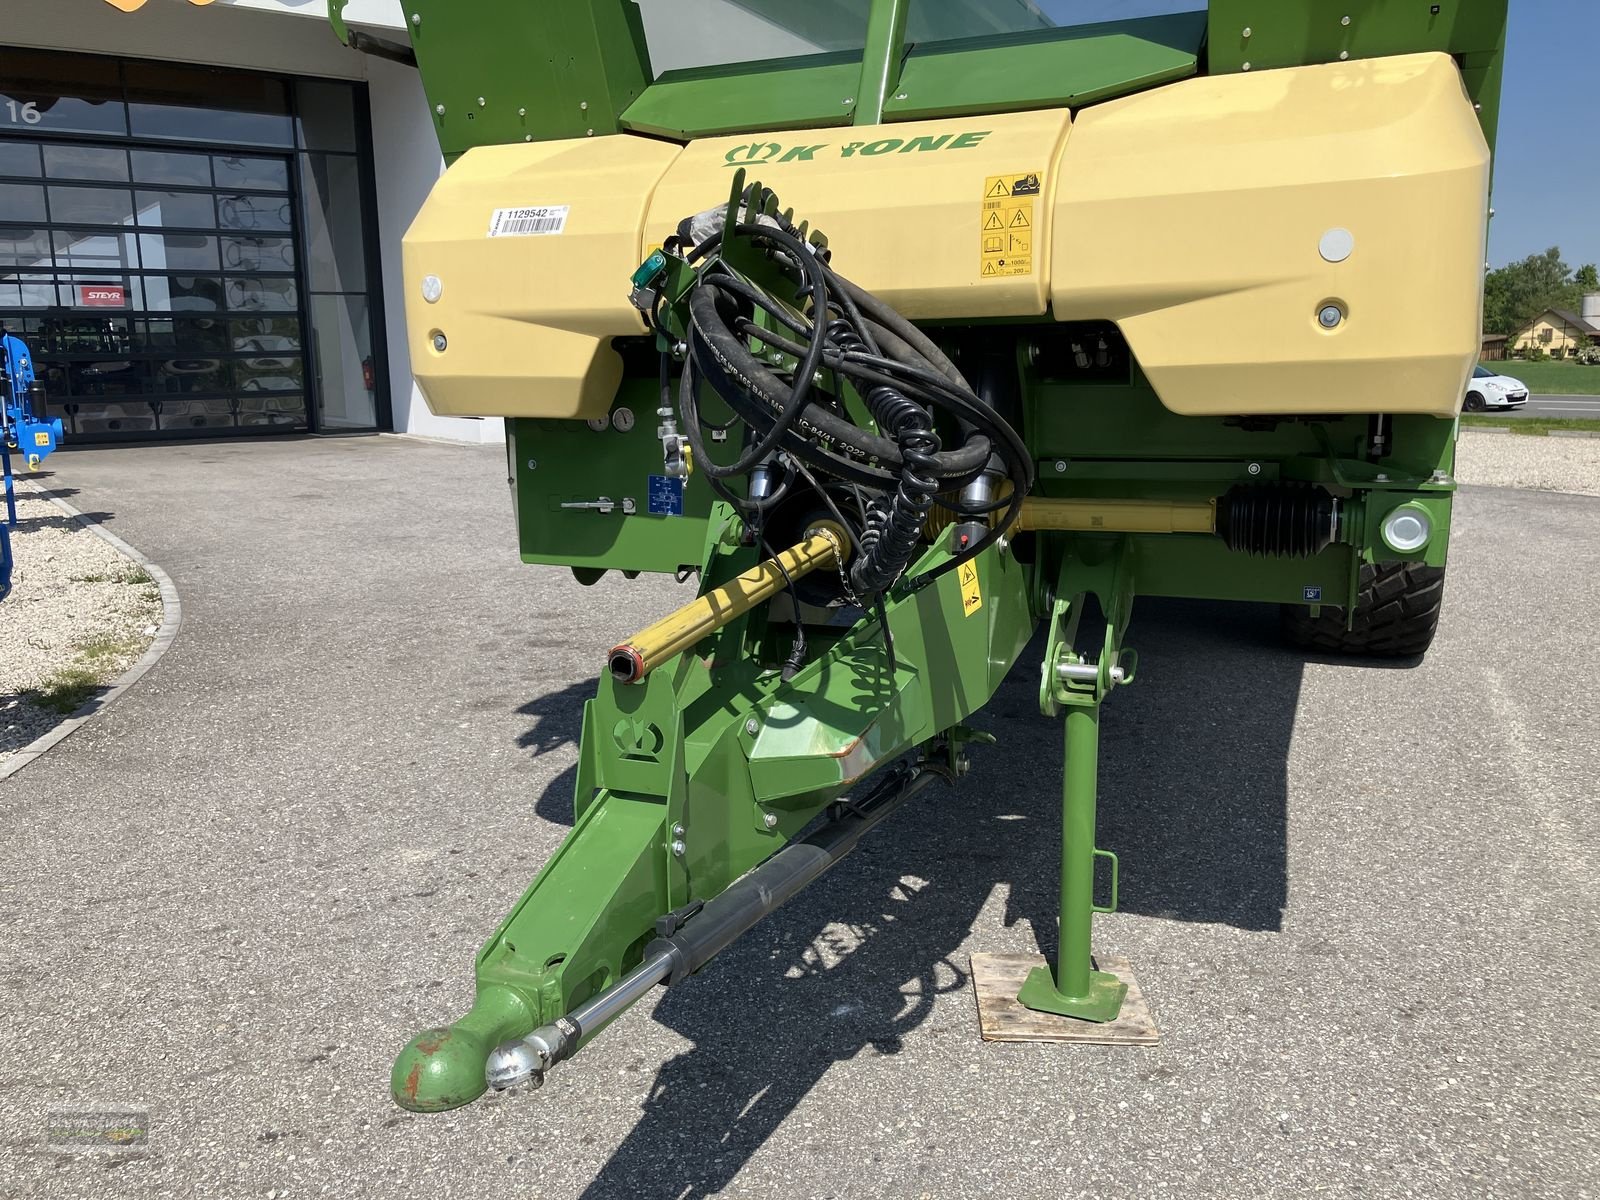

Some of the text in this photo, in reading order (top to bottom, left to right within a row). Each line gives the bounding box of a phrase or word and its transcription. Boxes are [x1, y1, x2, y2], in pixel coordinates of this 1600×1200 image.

[5, 100, 42, 124] 16
[508, 209, 548, 219] 1129542
[87, 291, 121, 299] STEYR
[752, 385, 769, 402] BAR
[839, 441, 866, 458] 2022
